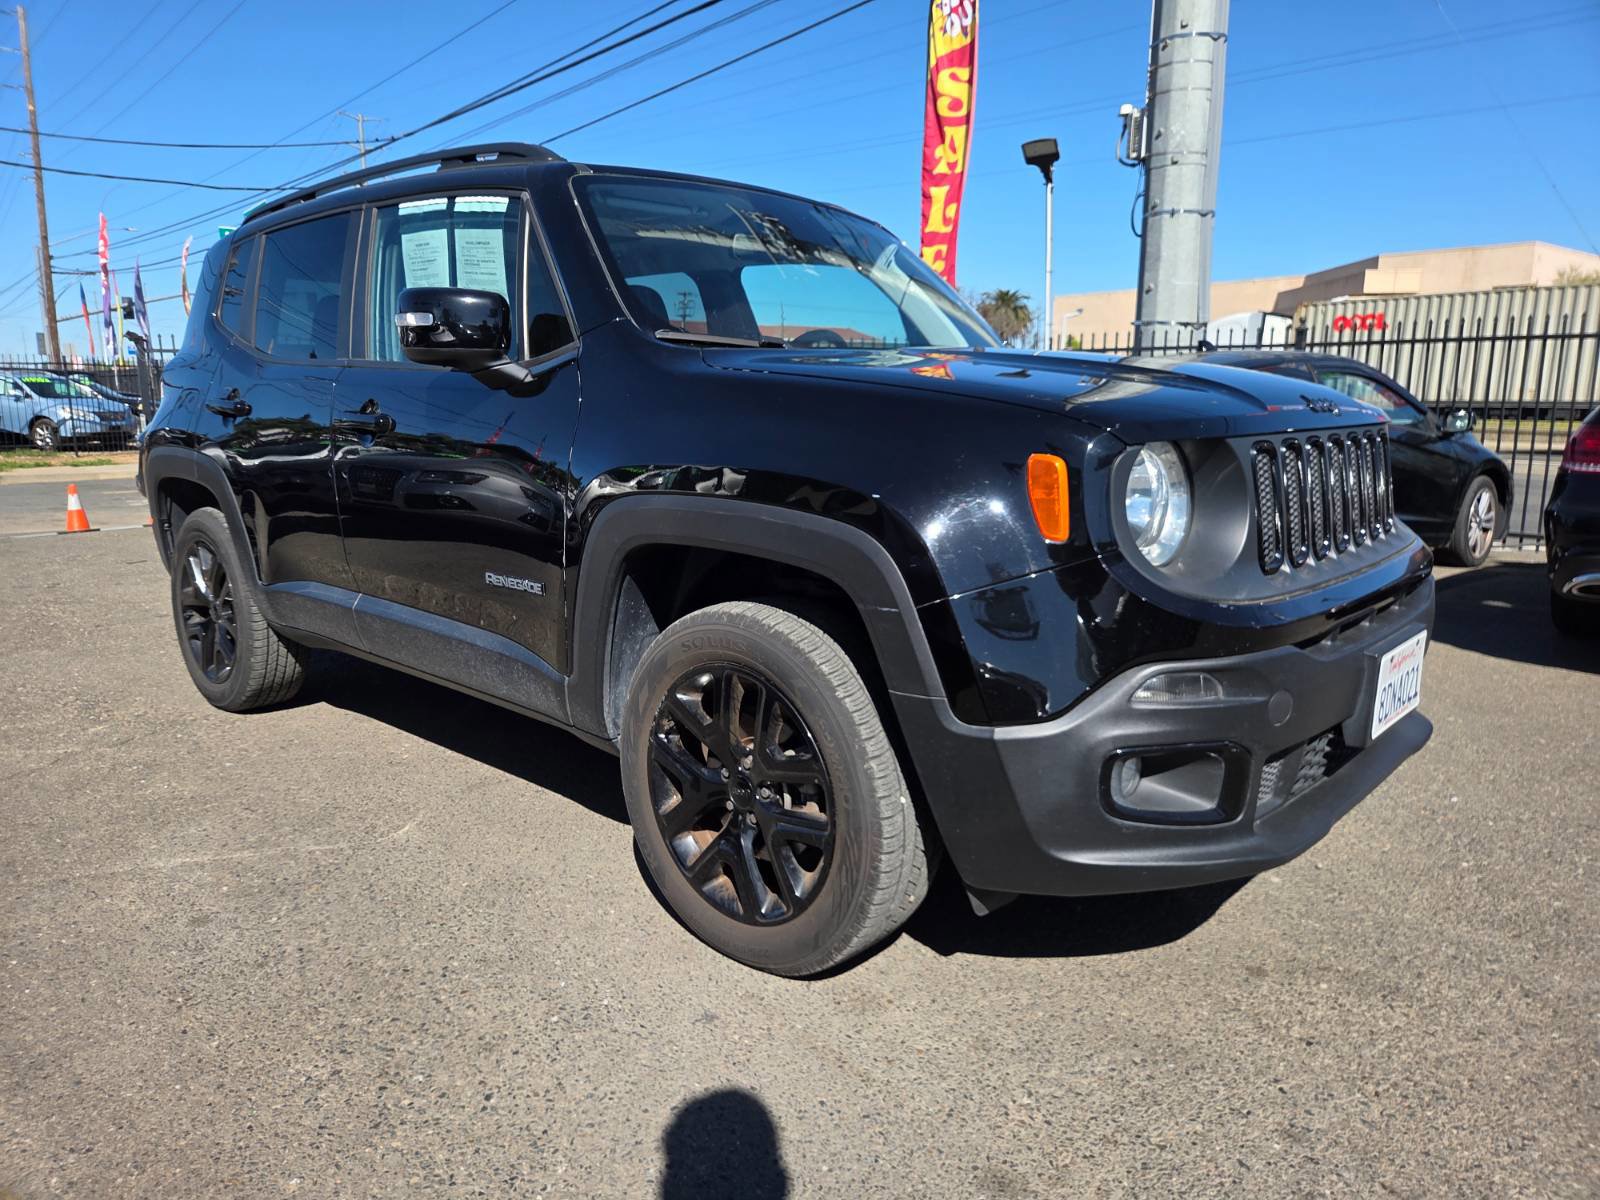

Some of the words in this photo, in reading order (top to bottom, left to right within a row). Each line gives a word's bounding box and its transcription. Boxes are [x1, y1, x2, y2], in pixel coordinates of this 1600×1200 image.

[921, 66, 972, 280] SALE
[485, 572, 543, 596] RENEGADE
[1378, 663, 1419, 723] 8DNA021
